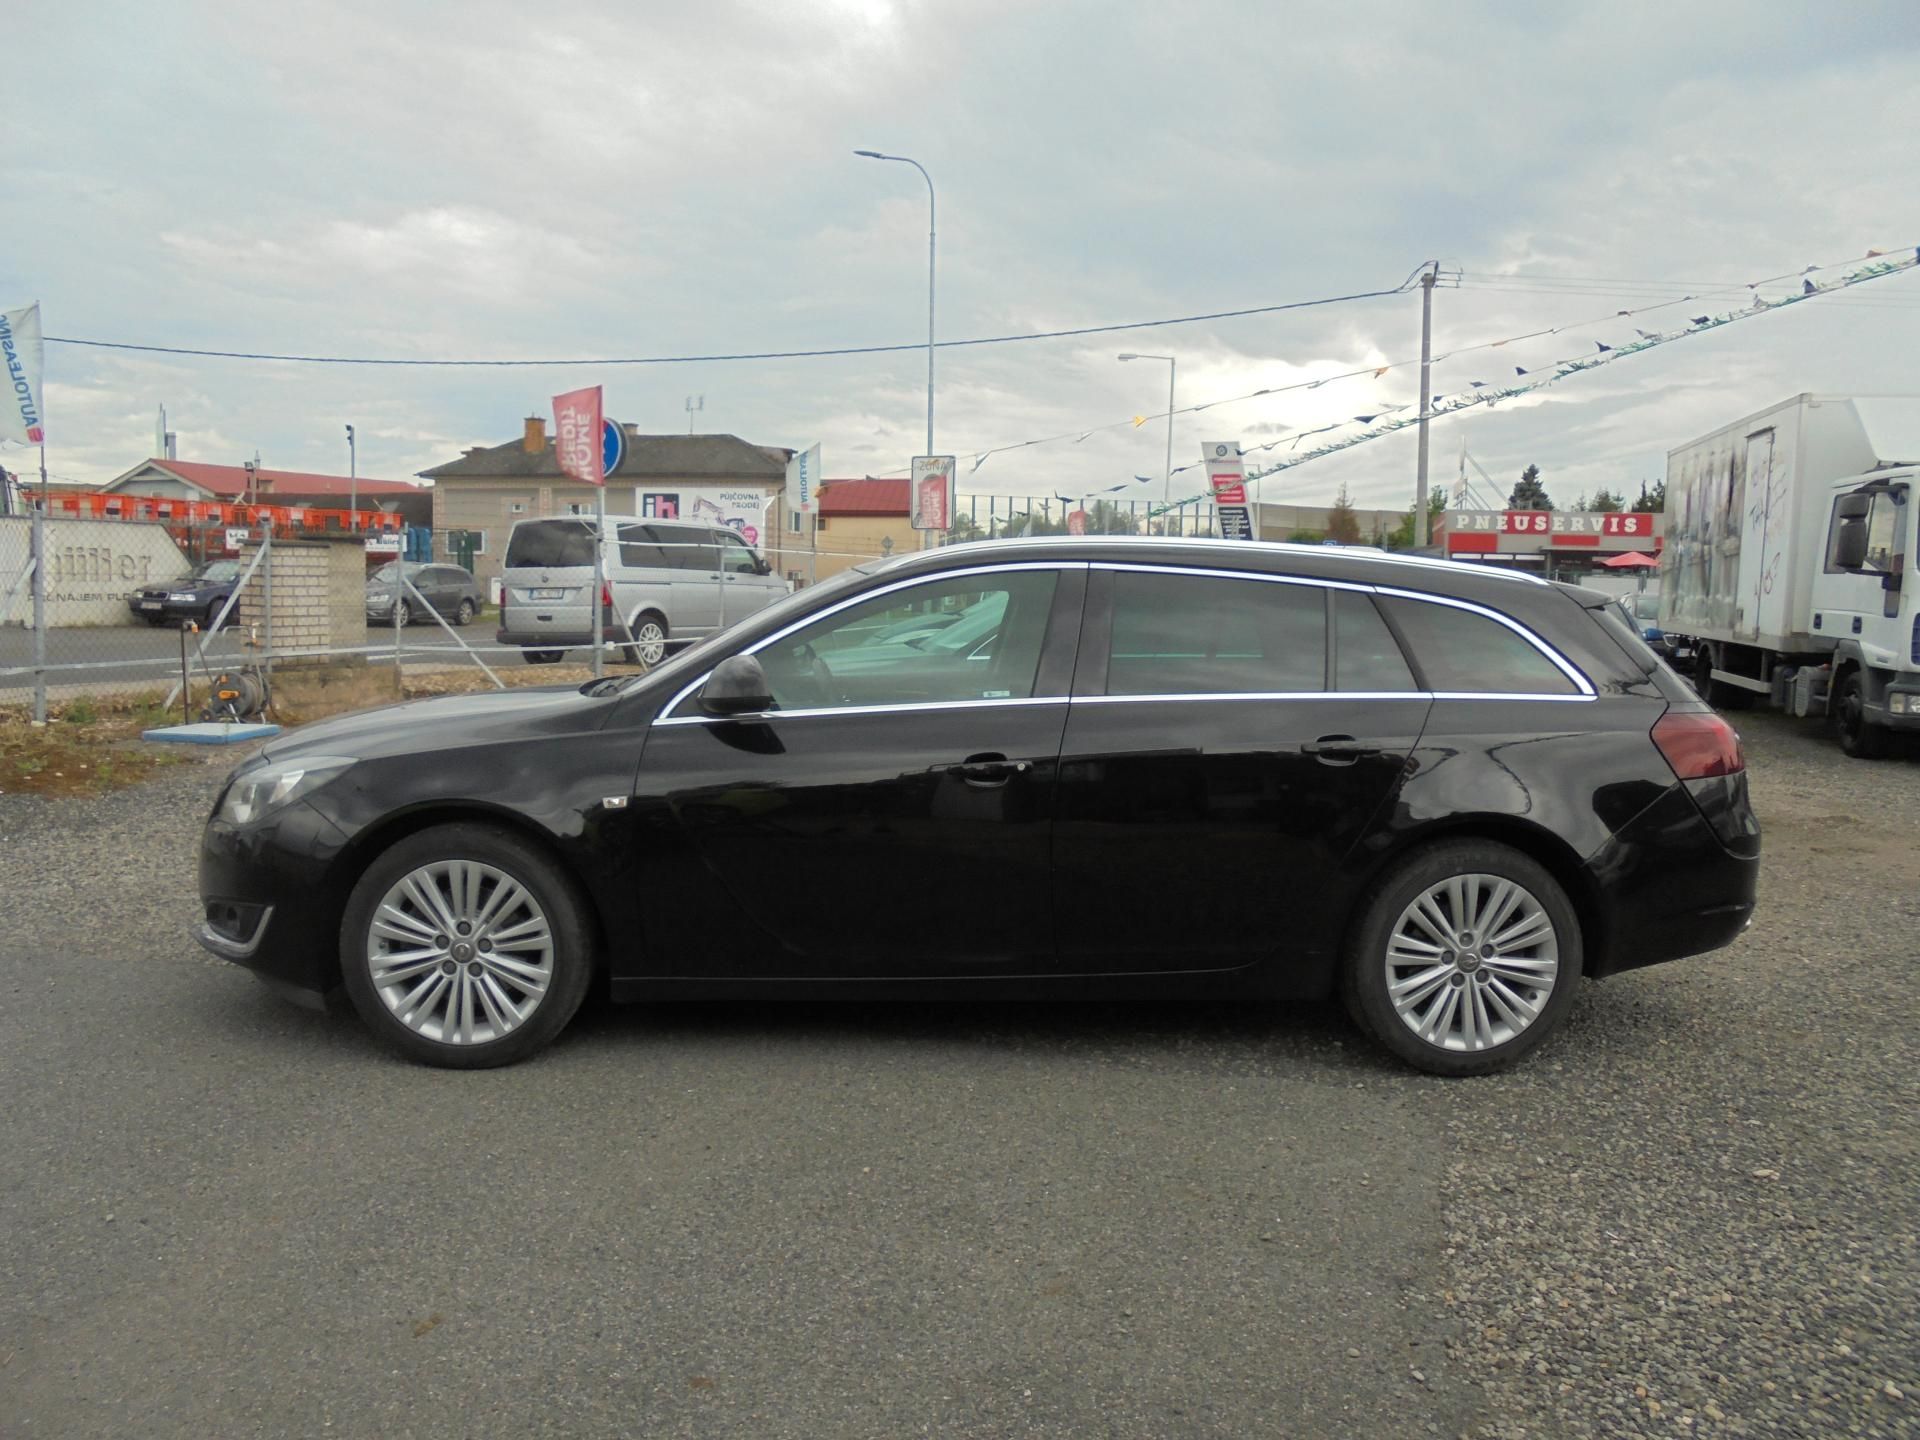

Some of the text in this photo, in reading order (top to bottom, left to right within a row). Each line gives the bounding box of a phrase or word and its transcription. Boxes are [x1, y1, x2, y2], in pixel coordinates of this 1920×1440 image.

[732, 502, 759, 510] PRODEJ
[1456, 515, 1638, 533] PNEUSERVIS
[52, 546, 152, 582] üller
